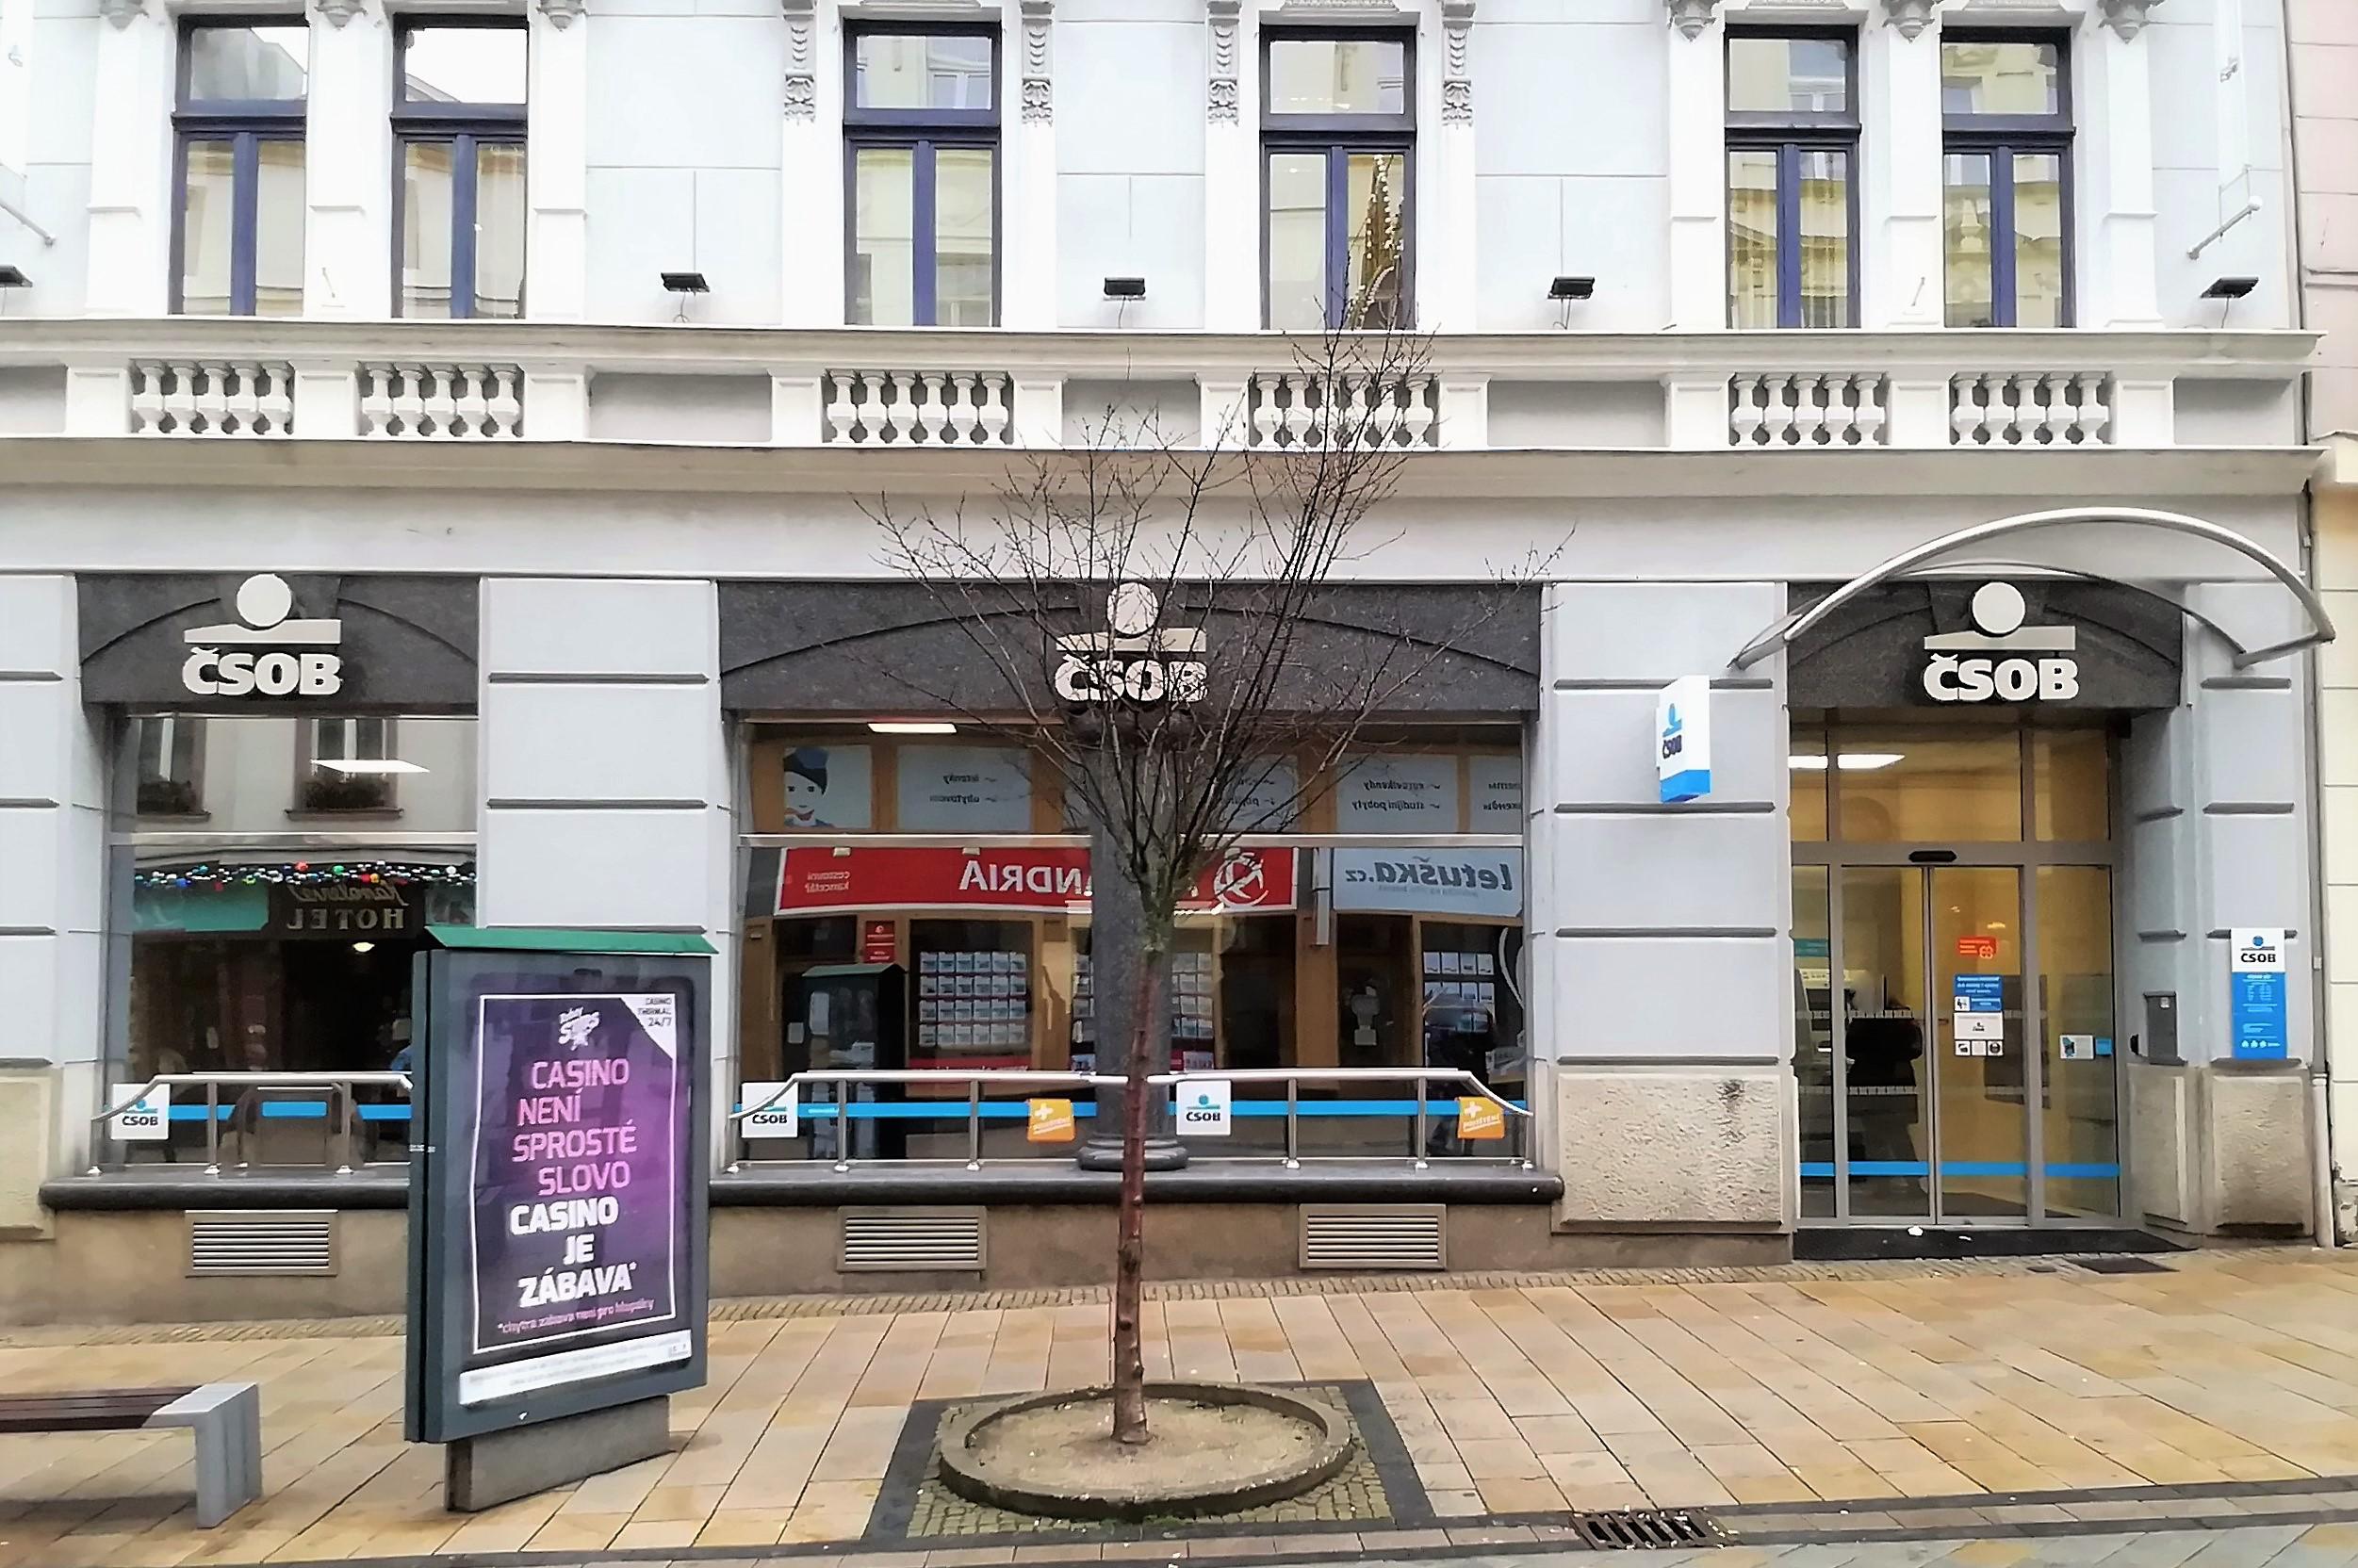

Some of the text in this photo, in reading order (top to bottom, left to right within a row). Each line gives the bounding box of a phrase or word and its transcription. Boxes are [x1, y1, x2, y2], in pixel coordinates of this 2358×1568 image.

[182, 646, 343, 695] ČSOB
[1055, 653, 1208, 701] ČSOB
[1924, 652, 2079, 701] ČSOB
[532, 1058, 630, 1090] CASINO
[517, 1087, 583, 1126] NENÍ
[512, 1119, 637, 1162] SPROSTÉ
[538, 1160, 630, 1196] SLOVO
[510, 1196, 619, 1235] CASINO
[563, 1233, 595, 1265] JE
